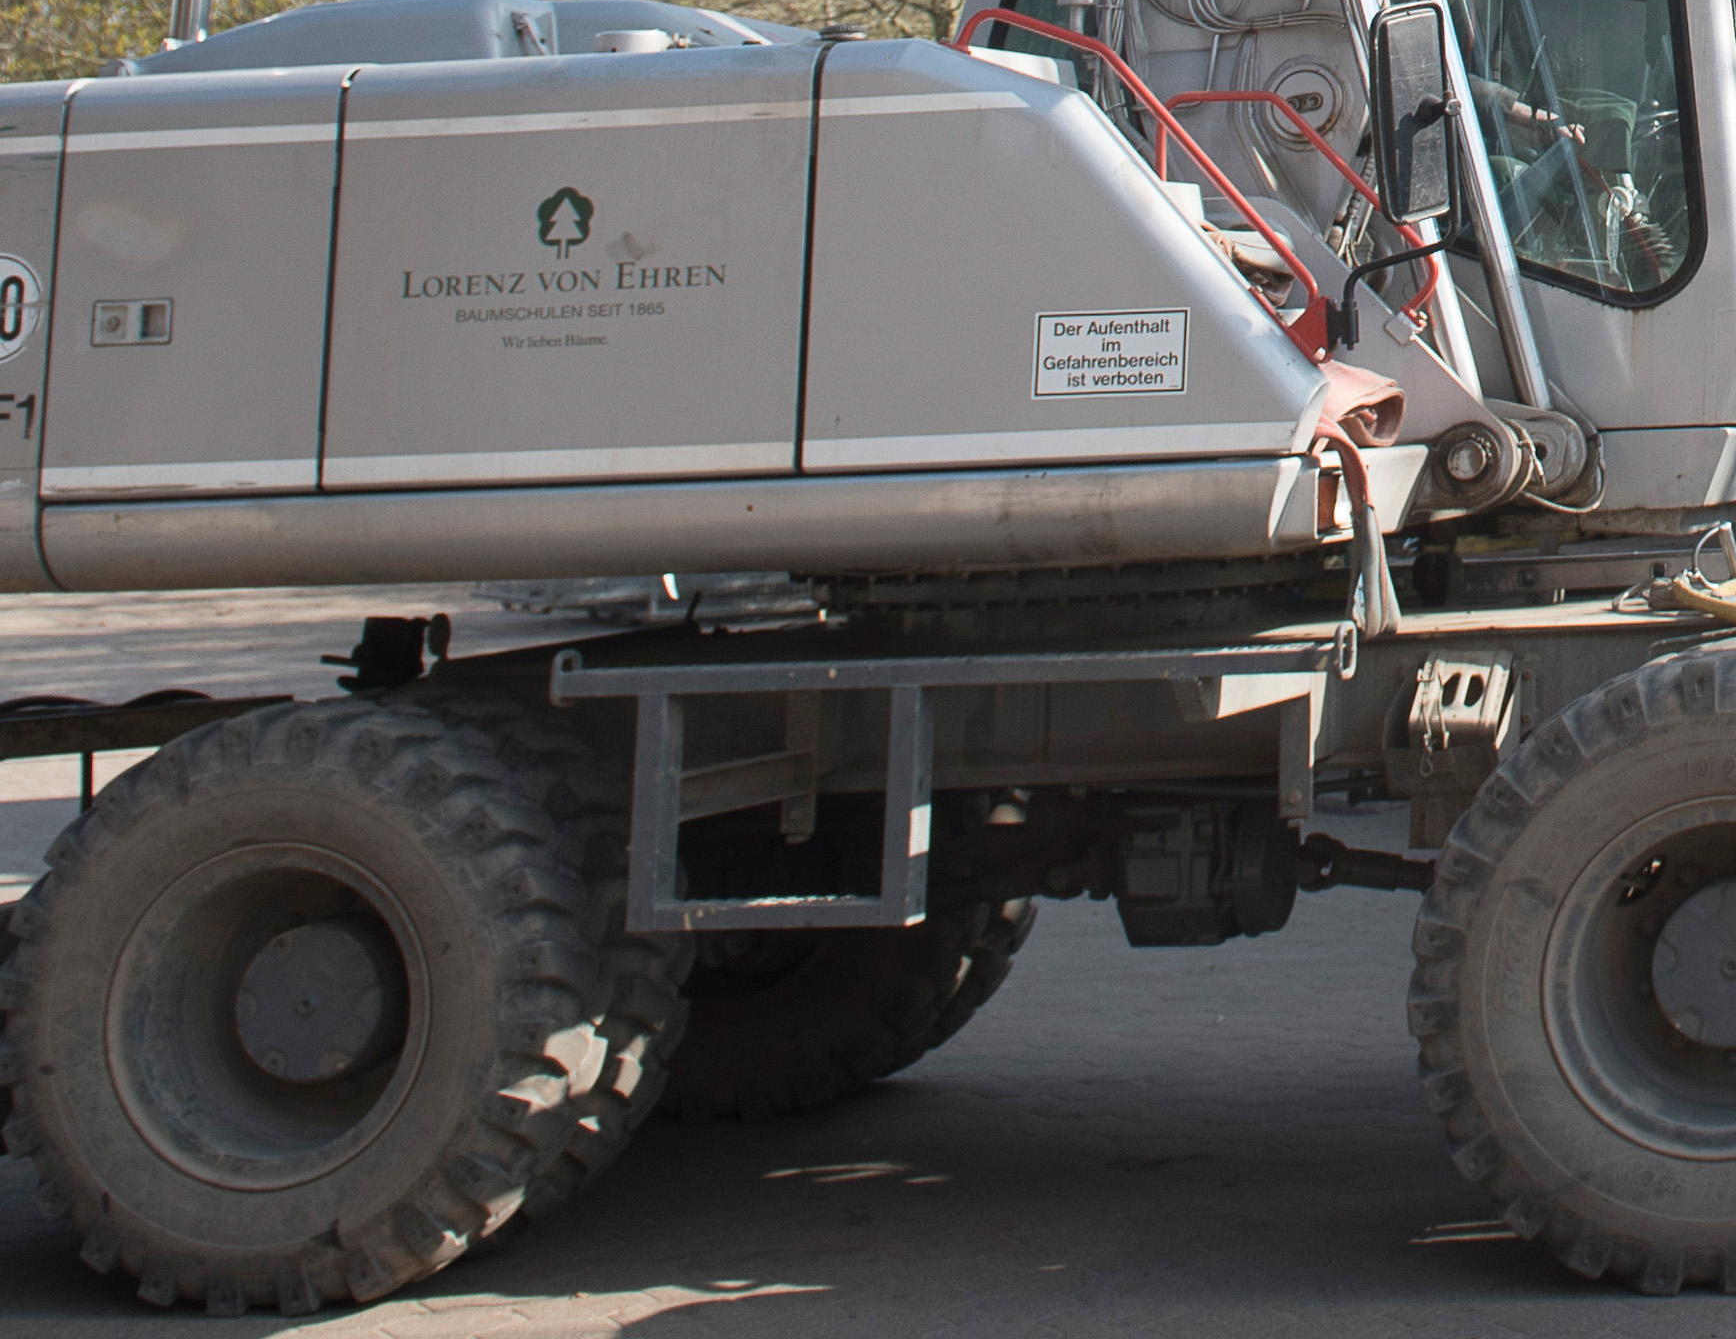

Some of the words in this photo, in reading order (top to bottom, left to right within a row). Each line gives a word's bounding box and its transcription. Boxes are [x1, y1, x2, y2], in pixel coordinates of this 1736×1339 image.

[402, 270, 526, 299] LORENZ
[537, 269, 601, 293] VON
[616, 260, 727, 290] EHREN
[455, 304, 584, 324] BAUMSCHULEN
[587, 302, 624, 319] SEIT
[628, 300, 666, 317] 1865
[1053, 322, 1083, 337] Der
[1086, 318, 1171, 336] Aufenthalt
[502, 335, 525, 349] Wir
[527, 335, 563, 349] lieben
[1101, 338, 1122, 353] im
[1043, 351, 1179, 371] Gefahrenbereich
[1066, 372, 1087, 388] ist
[1092, 370, 1164, 387] verboten
